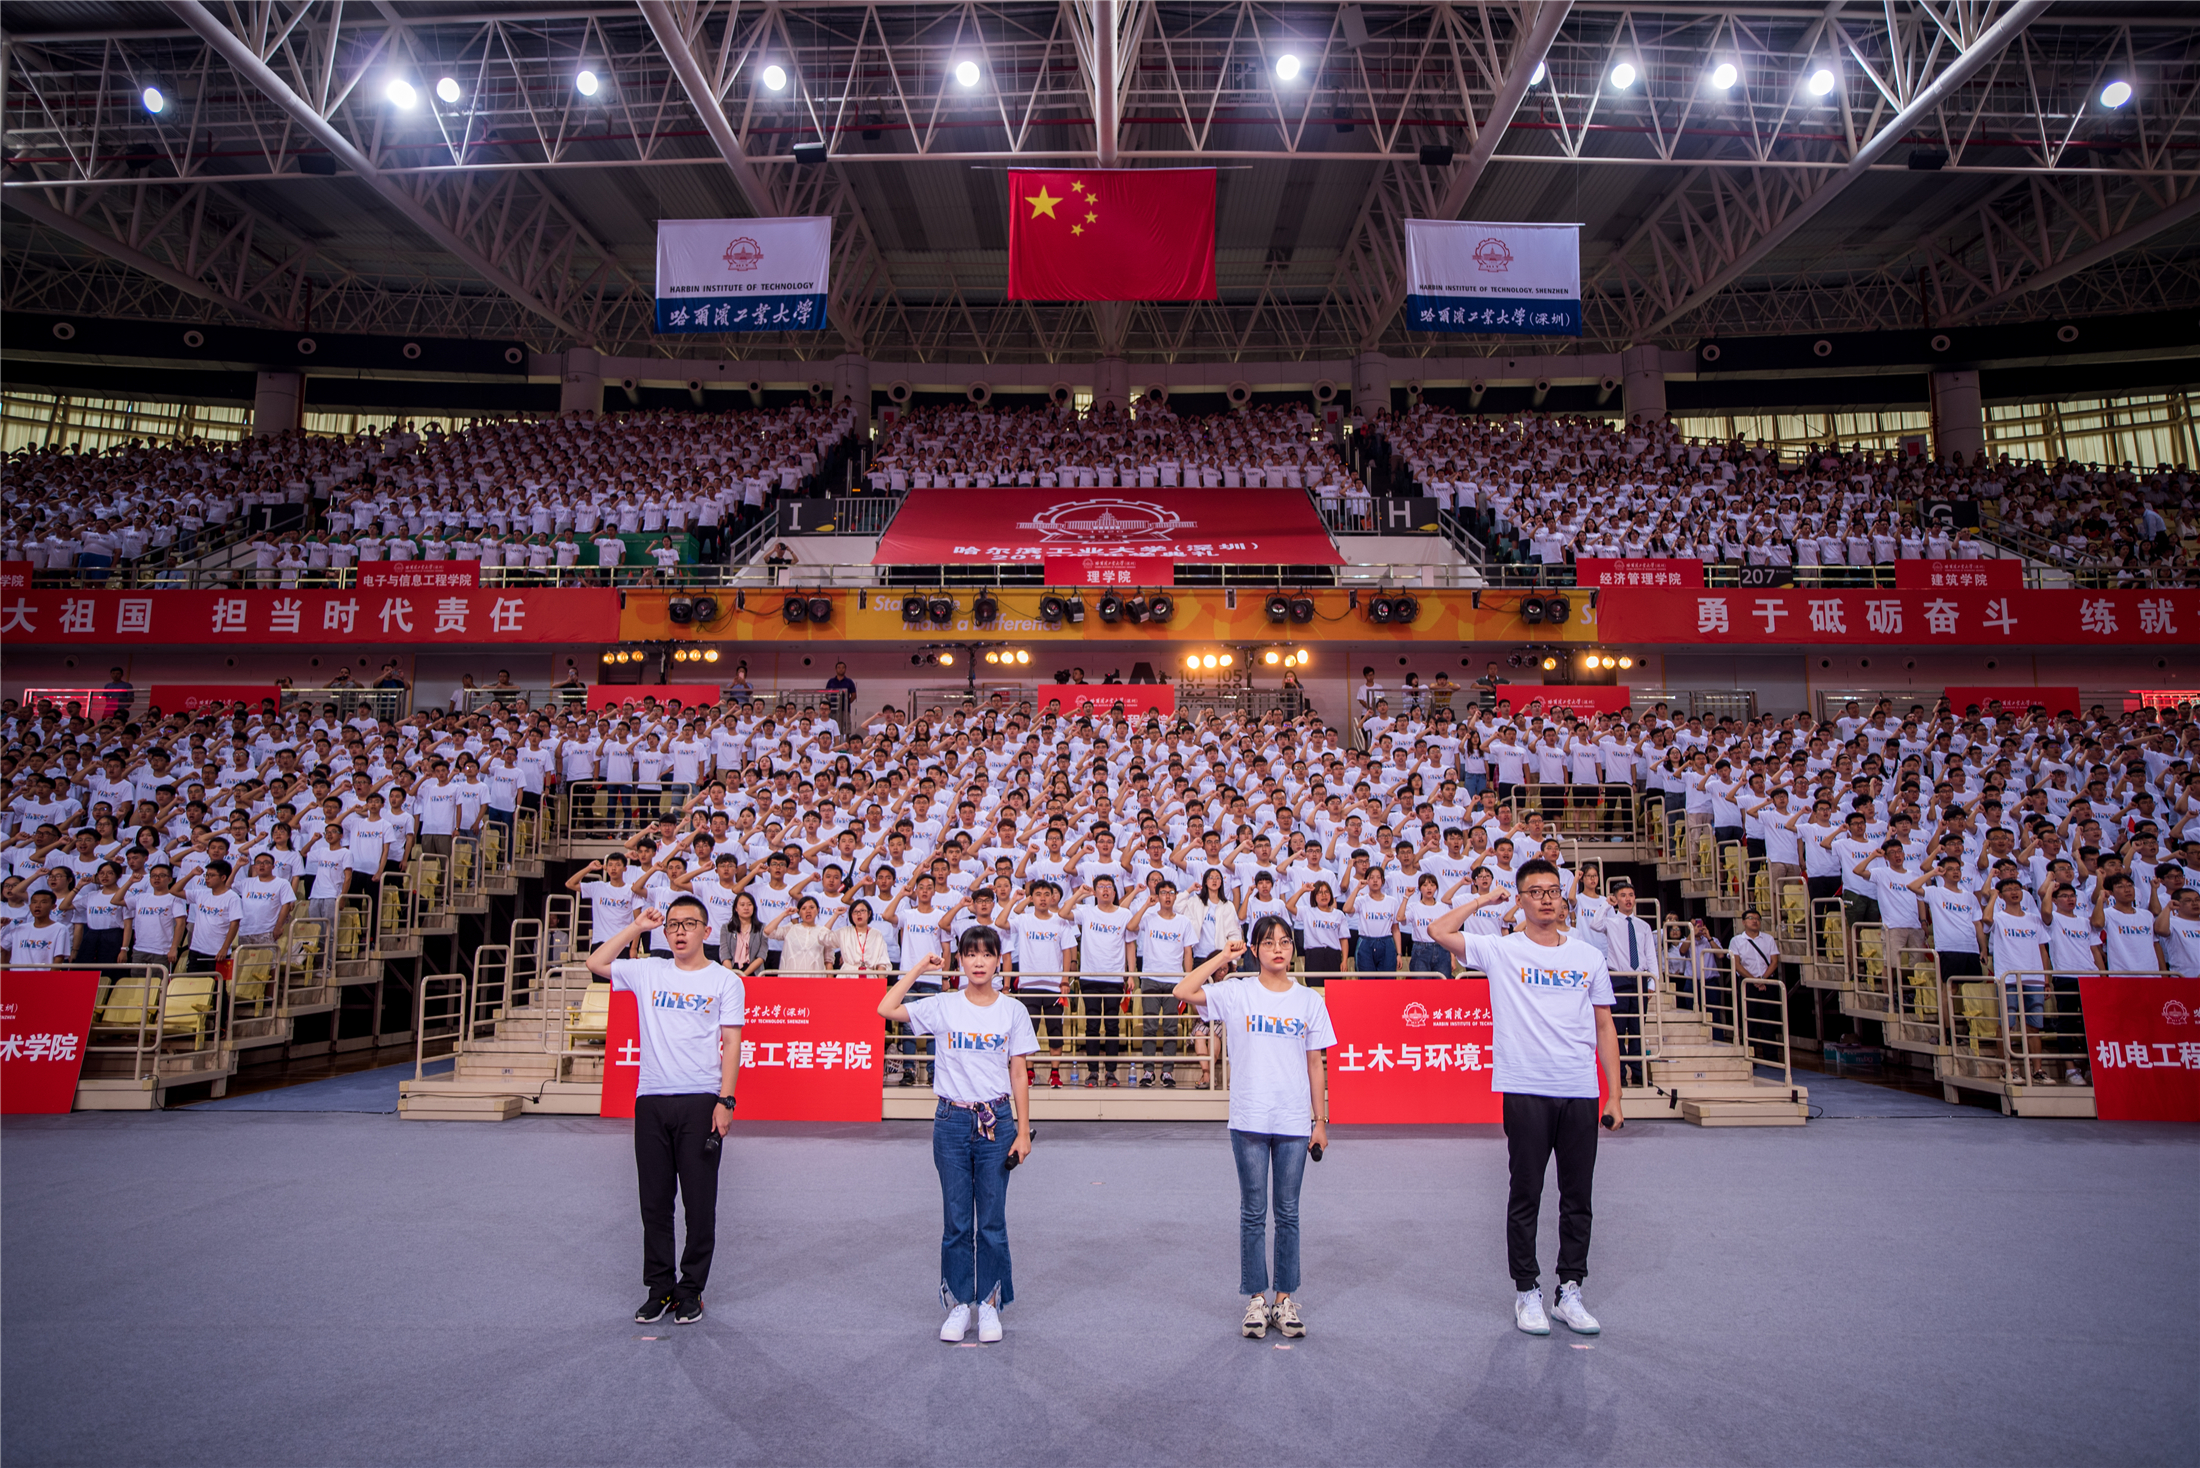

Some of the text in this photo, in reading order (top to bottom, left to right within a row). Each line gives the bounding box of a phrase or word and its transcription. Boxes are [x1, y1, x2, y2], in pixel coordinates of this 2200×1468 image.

[669, 282, 814, 293] HARBIN INSTITUTE OF TECHNOLOGY
[1479, 285, 1488, 293] OF
[1536, 287, 1569, 295] SHENZHEN
[1388, 500, 1411, 528] H
[363, 574, 472, 588] 电子与信息工程学院
[1086, 570, 1132, 584] 理学院
[1599, 572, 1682, 586] 经济管理学院
[1742, 568, 1775, 585] 207
[1931, 573, 1988, 587] 建筑学院
[212, 597, 526, 634] 担当时代责任
[1697, 597, 2200, 635] 勇于砥砺奋斗 练就
[1521, 967, 1589, 988] HITSZ
[652, 990, 714, 1014] HITSZ
[1246, 1014, 1308, 1039] HITSZ
[0, 1033, 79, 1062] 术学院
[948, 1031, 1009, 1053] HITSZ
[615, 1039, 873, 1070] 土境工程学院
